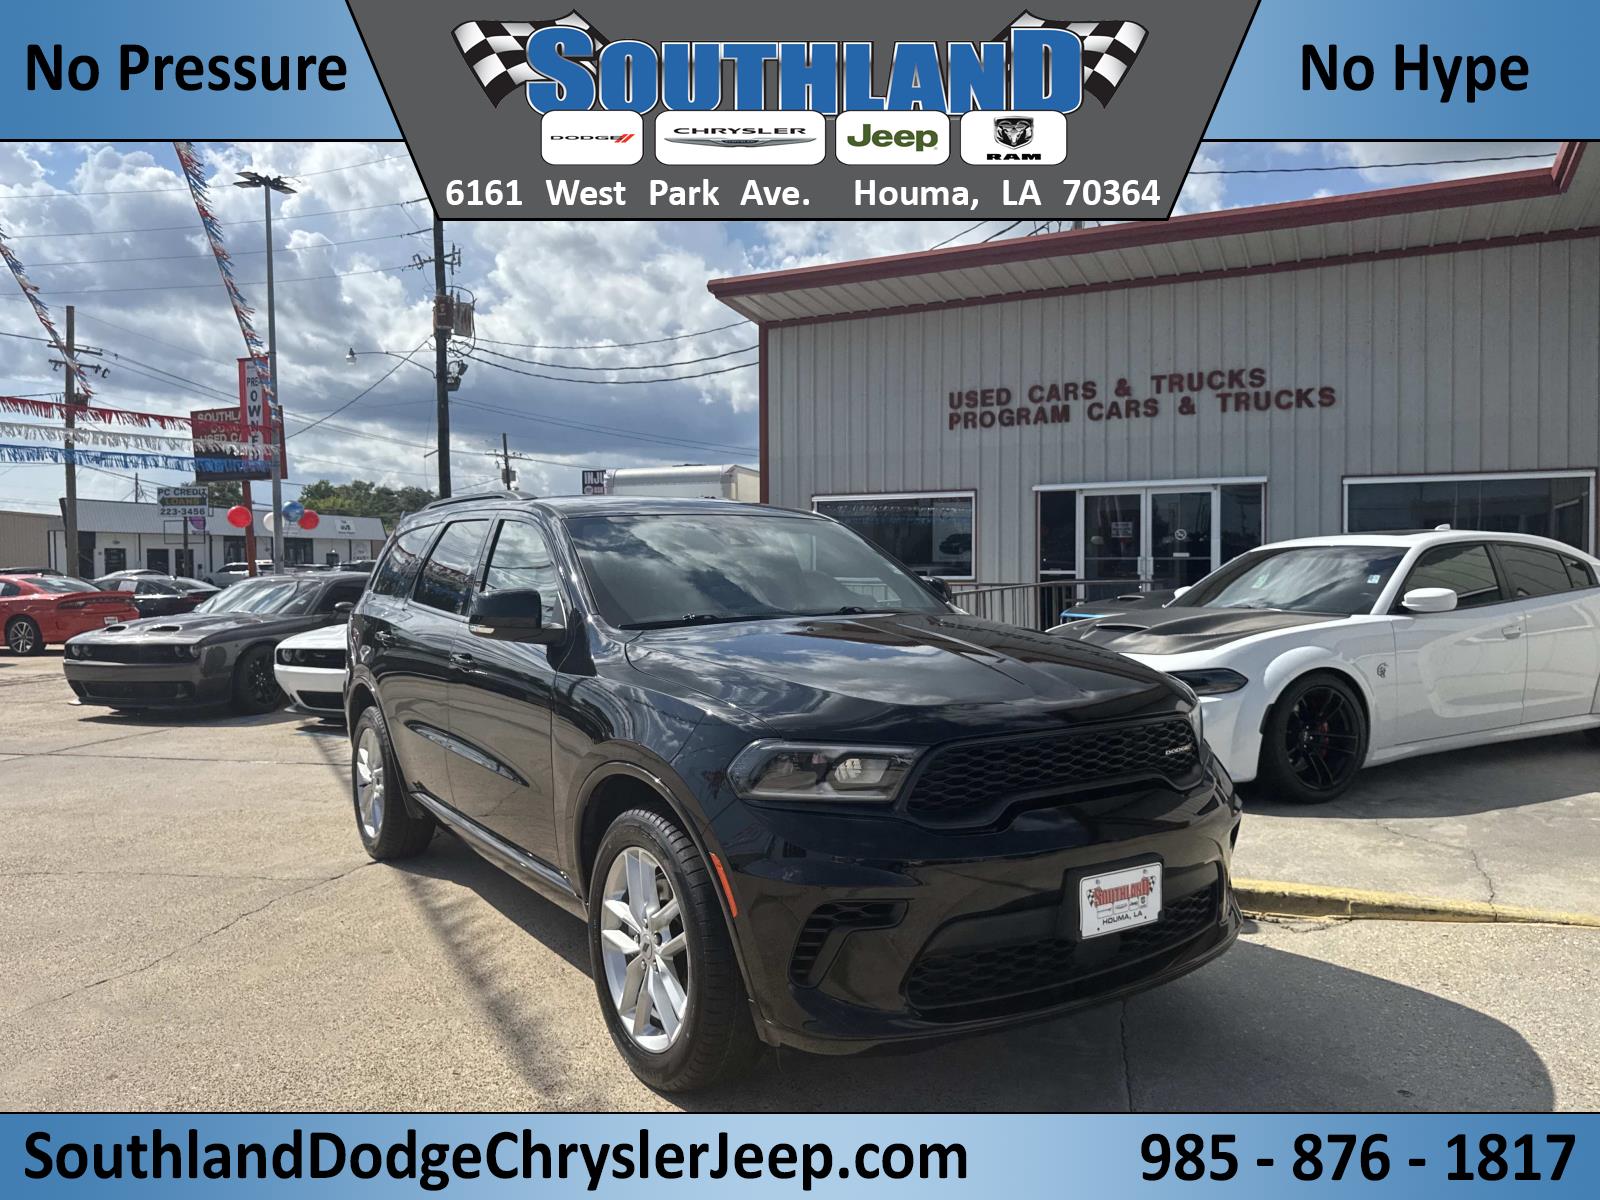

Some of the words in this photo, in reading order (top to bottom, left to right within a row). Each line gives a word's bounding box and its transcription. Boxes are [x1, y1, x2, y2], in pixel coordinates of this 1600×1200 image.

[949, 387, 1012, 410] USED
[1027, 380, 1097, 404] CARS
[1114, 377, 1132, 398] &
[1150, 367, 1266, 395] TRUCKS
[949, 404, 1070, 431] PROGRAM
[1086, 397, 1159, 422] CARS
[1177, 395, 1196, 416] &
[1215, 386, 1336, 413] TRUCKS
[1102, 914, 1131, 925] HOUMA,
